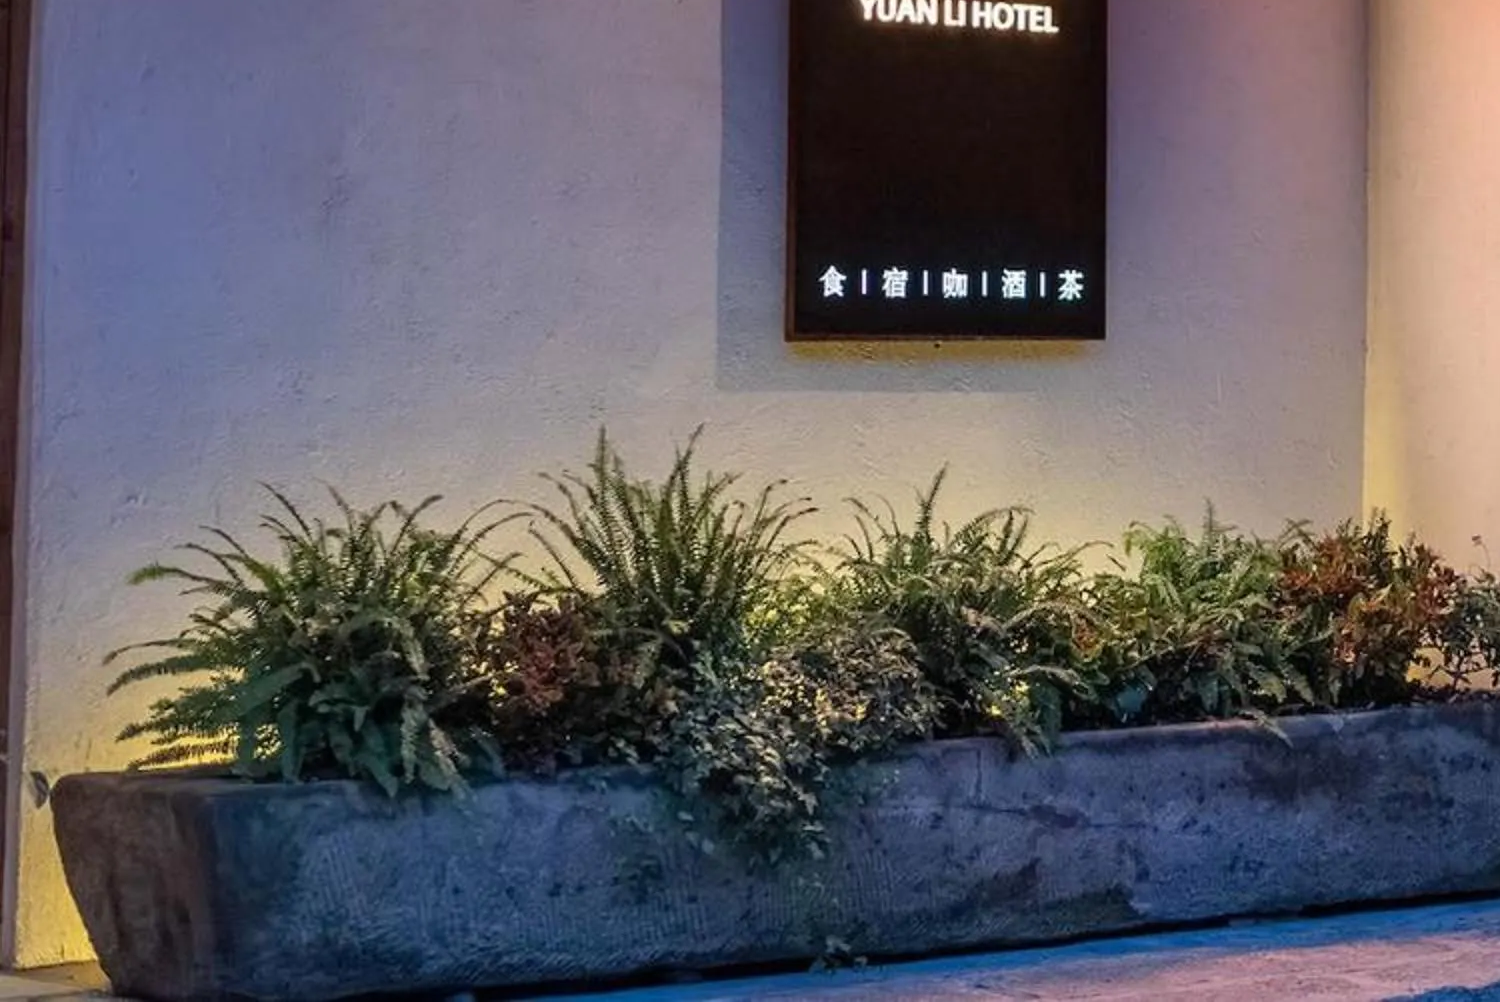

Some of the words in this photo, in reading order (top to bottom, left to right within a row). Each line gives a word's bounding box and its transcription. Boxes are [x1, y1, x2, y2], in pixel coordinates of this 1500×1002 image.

[971, 0, 1059, 34] HOTEL
[819, 265, 847, 297] 食
[882, 266, 909, 298] 宿
[942, 268, 969, 299] 咖
[1001, 269, 1027, 299] 酒
[1058, 269, 1084, 300] 茶
